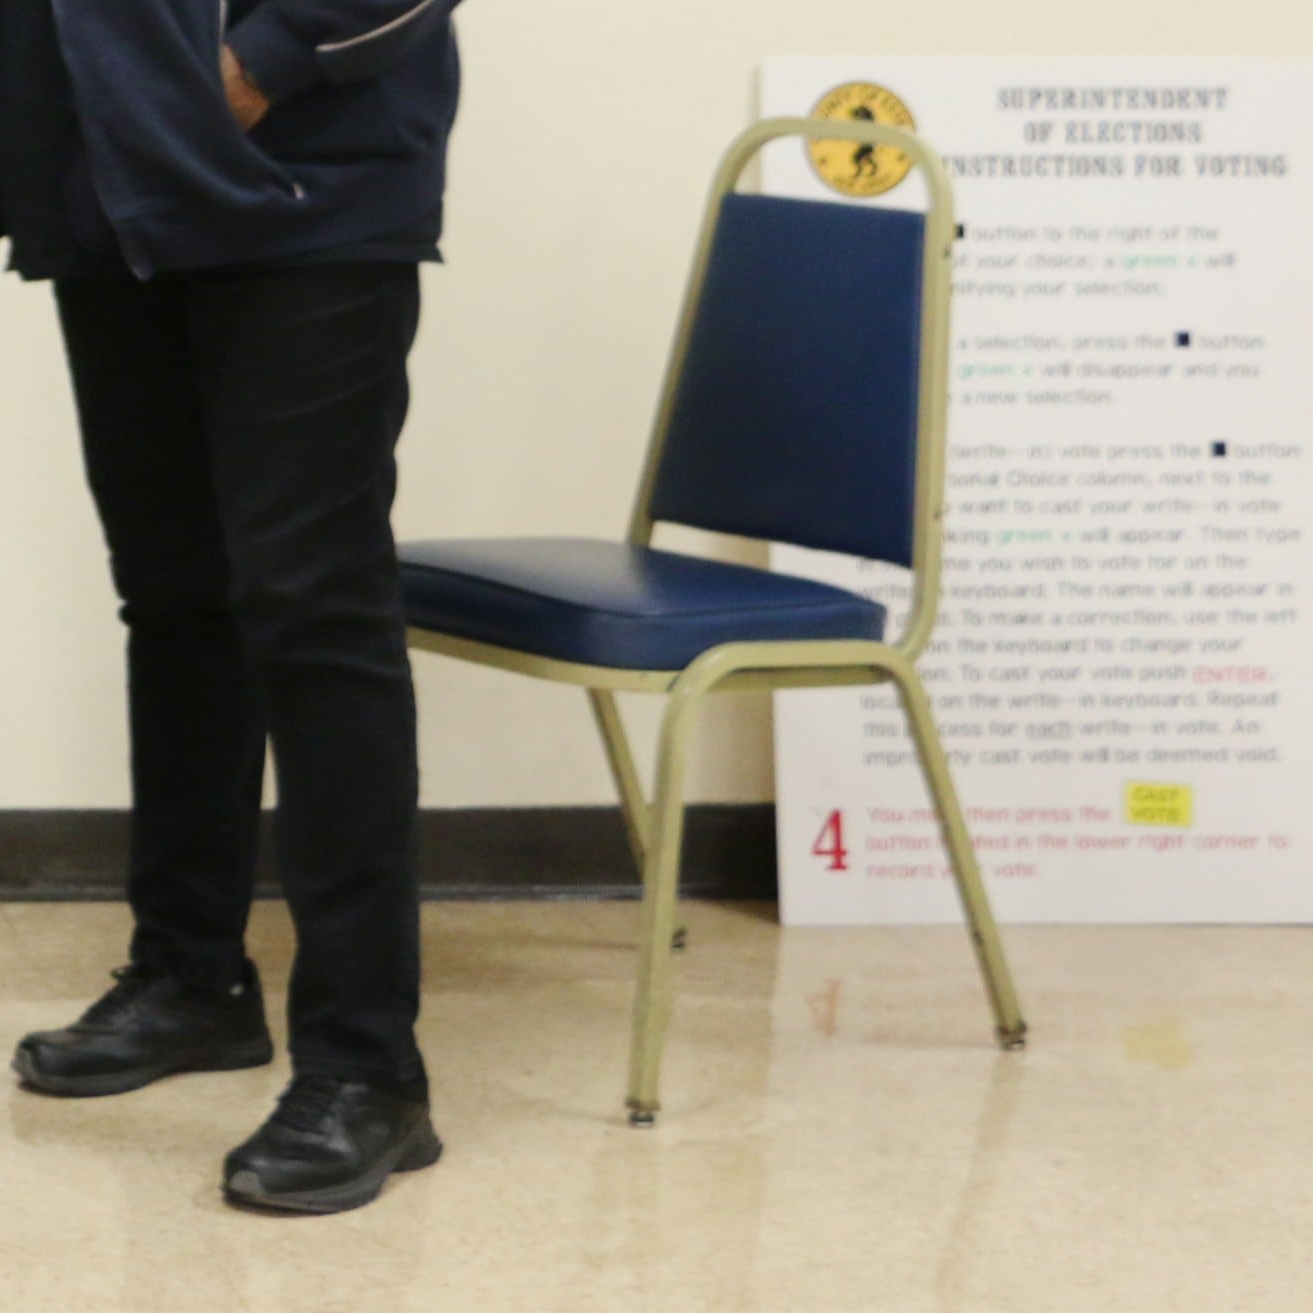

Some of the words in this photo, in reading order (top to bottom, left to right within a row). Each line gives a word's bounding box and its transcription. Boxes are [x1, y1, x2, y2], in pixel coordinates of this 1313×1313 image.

[995, 86, 1228, 111] SUPERINTENDENT
[1023, 121, 1052, 143] OF
[1064, 121, 1203, 144] ELECTIONS
[1133, 154, 1182, 177] FOR
[1194, 154, 1288, 177] VOTING
[1043, 225, 1062, 242] to
[1070, 225, 1099, 242] the
[1160, 225, 1180, 242] of
[1187, 225, 1218, 242] the
[1122, 256, 1178, 272] green
[1204, 252, 1236, 269] will
[1134, 335, 1165, 351] the
[957, 363, 1015, 380] green
[1040, 361, 1071, 377] will
[1170, 443, 1200, 459] the
[1211, 471, 1230, 488] to
[1238, 470, 1271, 488] the
[1013, 497, 1033, 515] to
[1079, 527, 1110, 543] will
[1071, 554, 1090, 571] to
[1216, 554, 1247, 571] the
[1057, 582, 1093, 599] The
[1160, 582, 1194, 599] will
[1225, 609, 1257, 626] the
[956, 637, 987, 654] the
[1094, 637, 1113, 654] to
[968, 692, 998, 709] the
[1078, 747, 1111, 765] will
[1079, 805, 1111, 823] the
[811, 806, 849, 872] 4
[1037, 832, 1069, 850] the
